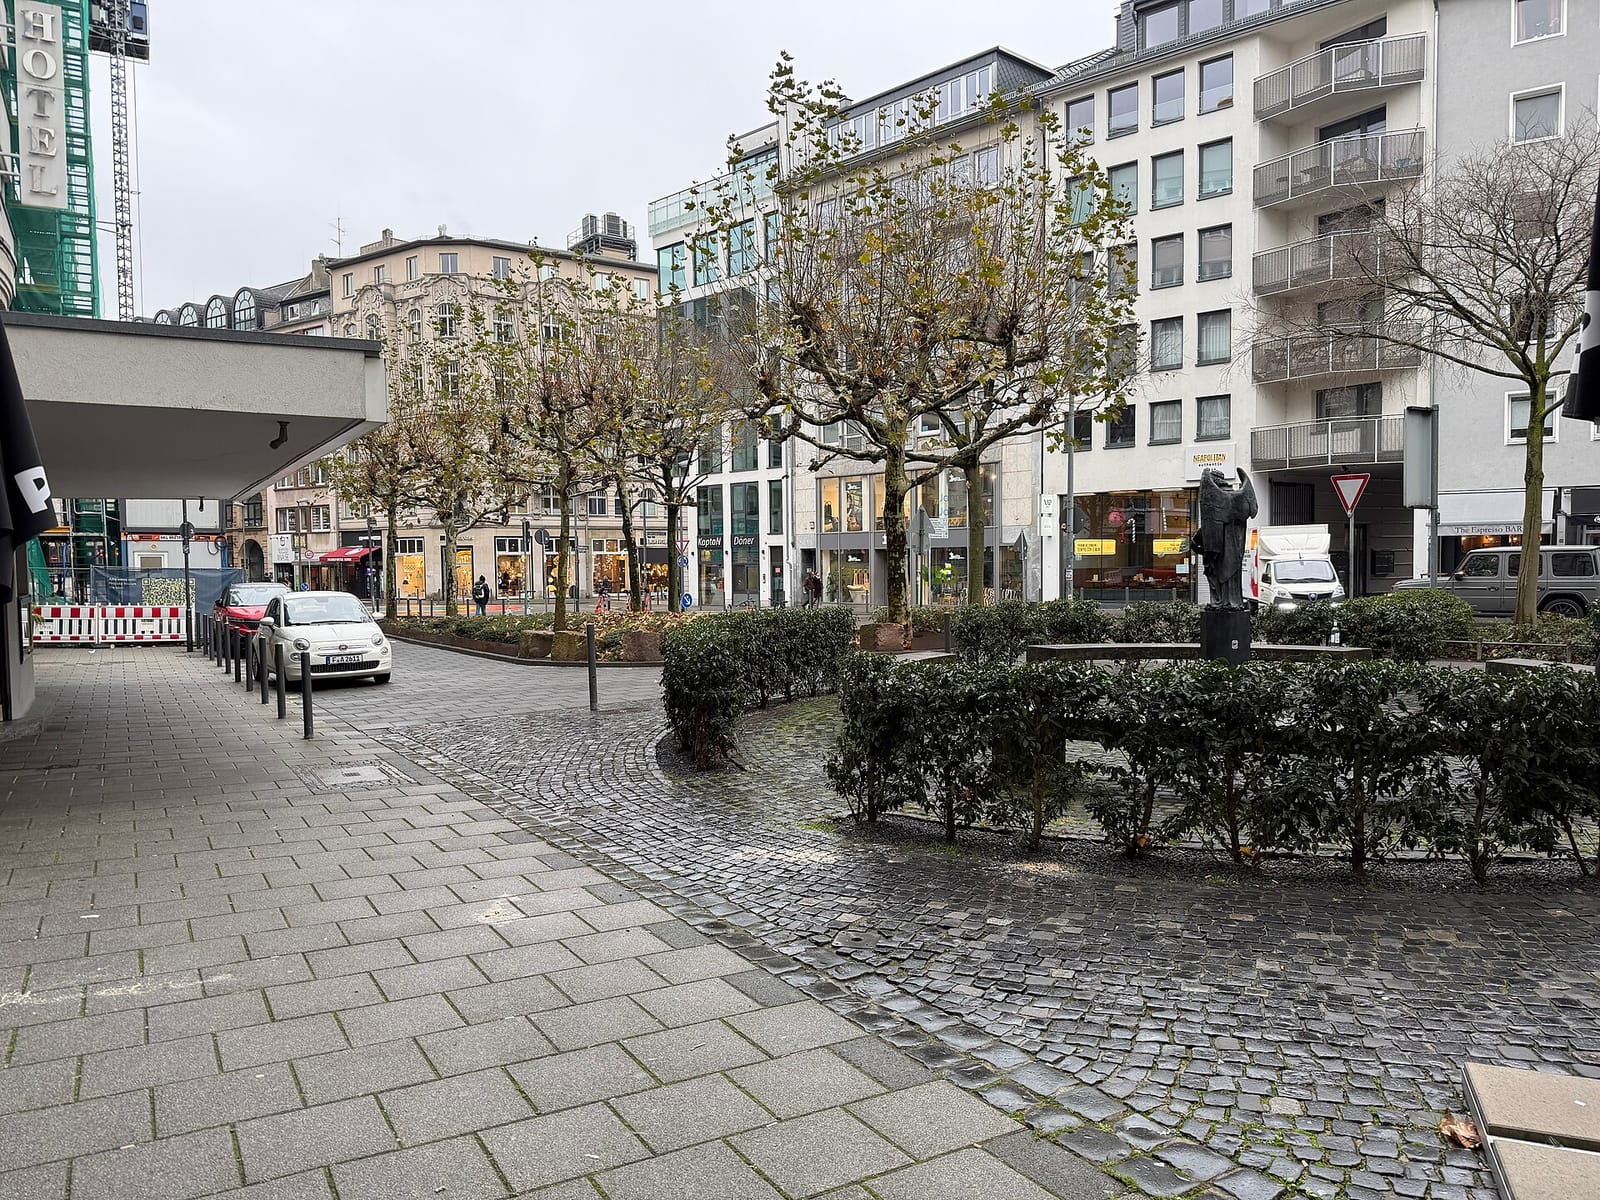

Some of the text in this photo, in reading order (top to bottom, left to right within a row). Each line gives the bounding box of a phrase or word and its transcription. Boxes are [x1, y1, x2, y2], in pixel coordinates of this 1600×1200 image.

[21, 10, 57, 196] HOTEL
[1192, 453, 1226, 463] NEAPOLITAN
[1471, 527, 1503, 536] Espresso
[1505, 525, 1523, 533] BAR
[697, 535, 755, 547] KaptaN Döner
